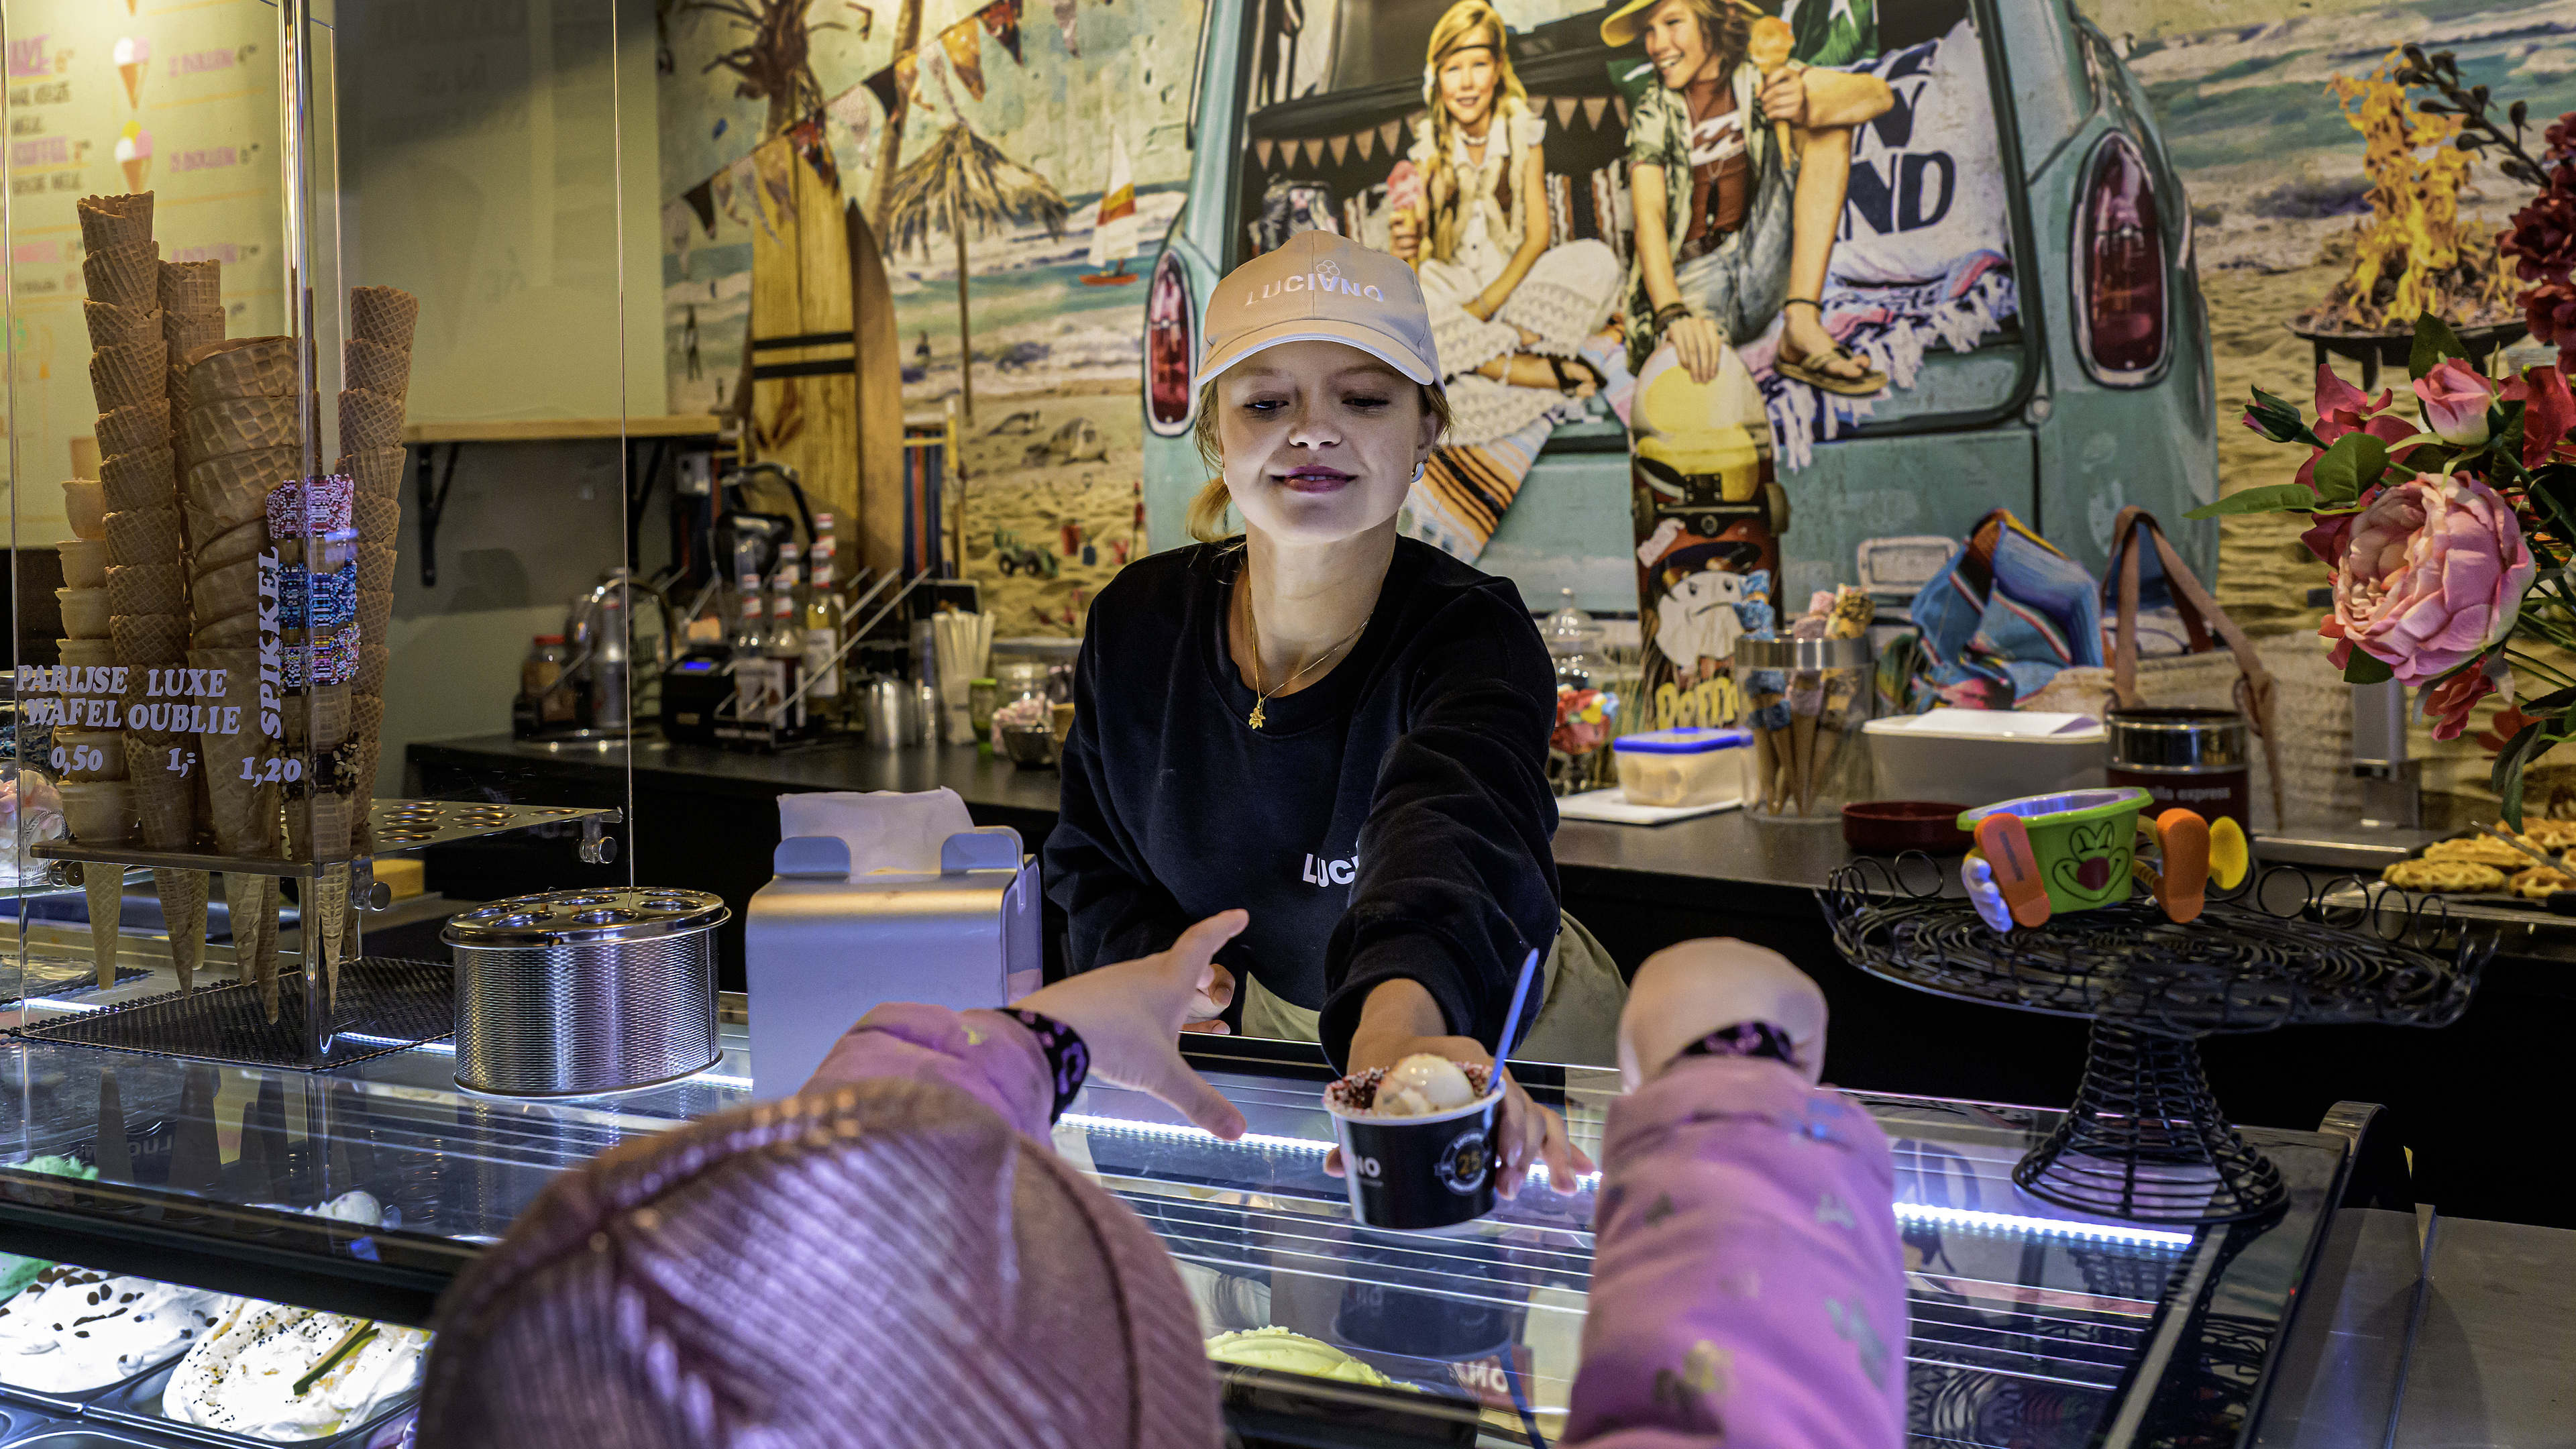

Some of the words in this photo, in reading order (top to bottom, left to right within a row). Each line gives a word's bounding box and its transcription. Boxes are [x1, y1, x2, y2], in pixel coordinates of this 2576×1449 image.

[1244, 272, 1384, 307] LUCIANO
[258, 546, 282, 739] SPIKKEL
[16, 664, 129, 694] PARIJSE
[146, 668, 227, 698] LUXE
[25, 697, 121, 728] WAFEL
[128, 702, 241, 735] OUBLIE
[50, 745, 103, 776] 0,50
[239, 756, 302, 788] 1,20
